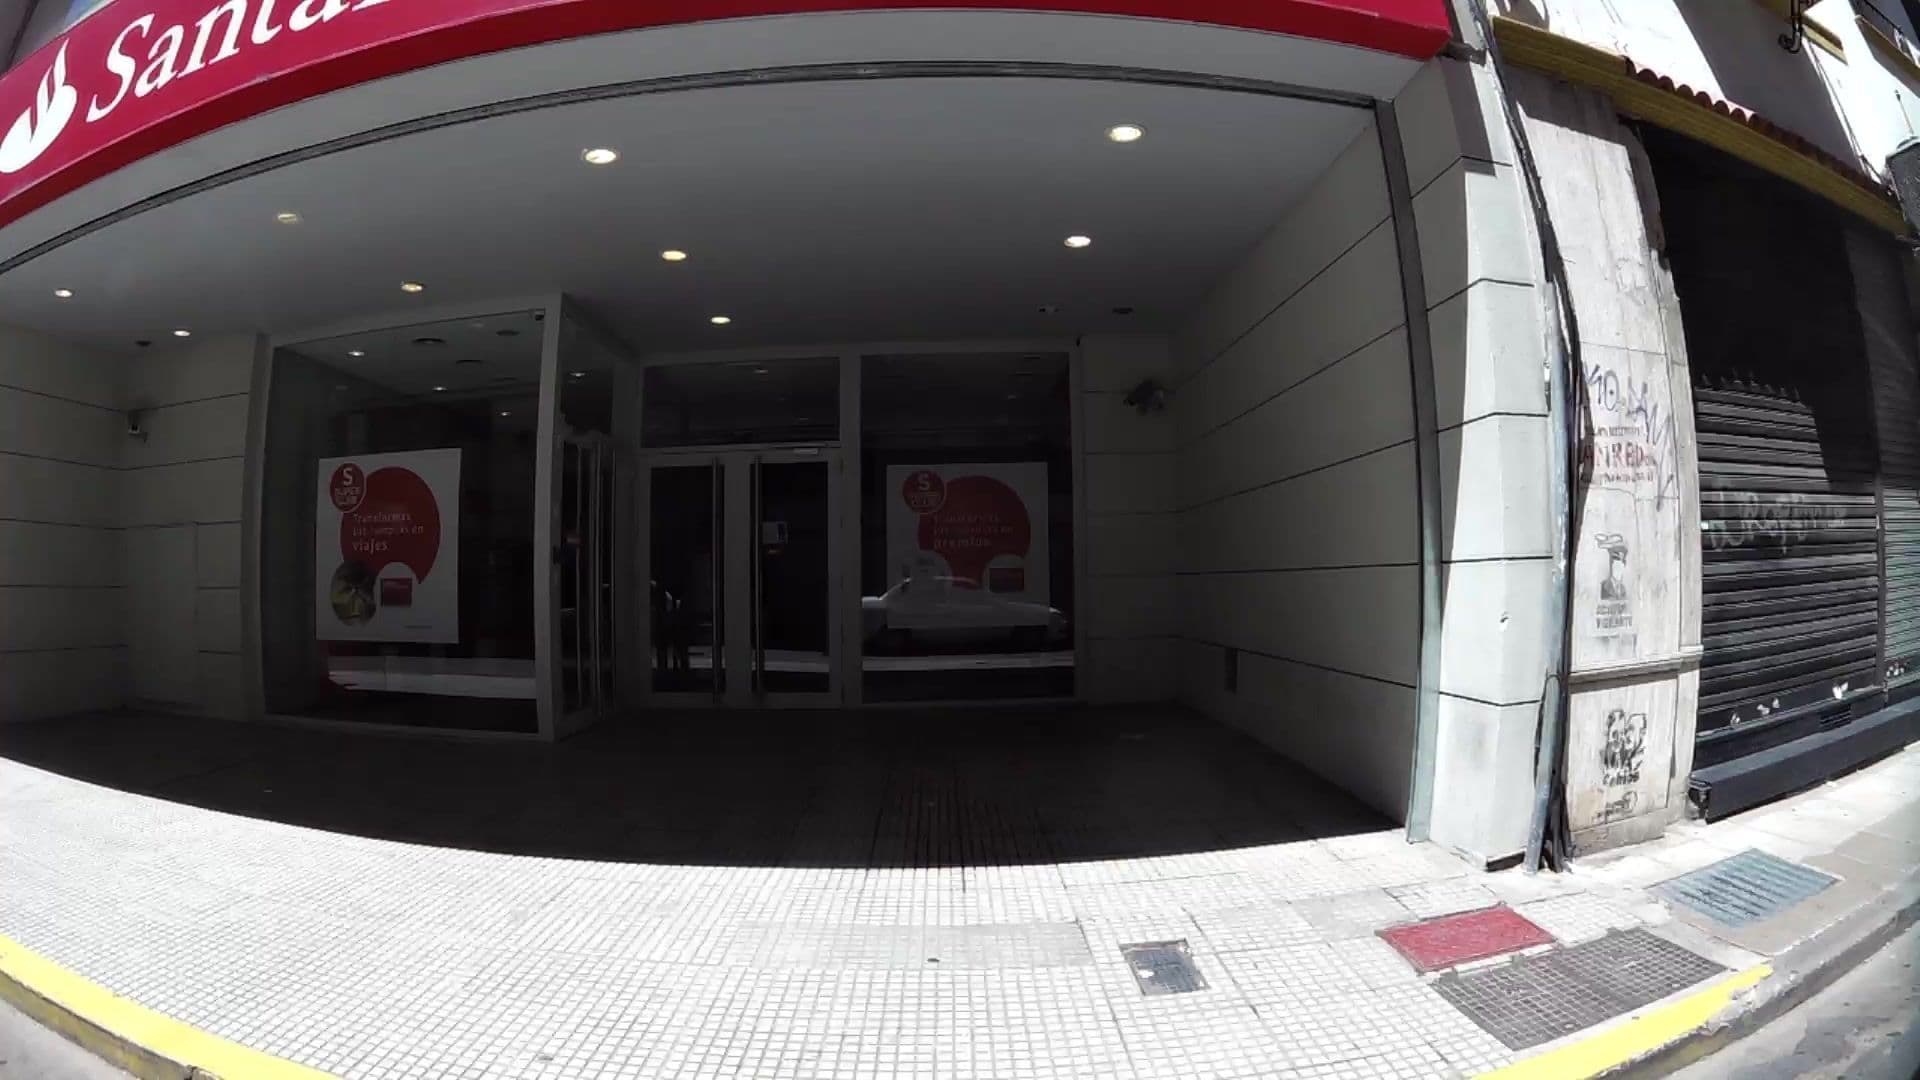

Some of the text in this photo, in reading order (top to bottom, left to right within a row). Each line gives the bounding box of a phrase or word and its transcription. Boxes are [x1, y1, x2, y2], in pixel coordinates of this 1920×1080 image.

[86, 0, 390, 123] Santa
[343, 467, 353, 486] S
[352, 538, 389, 555] viajes
